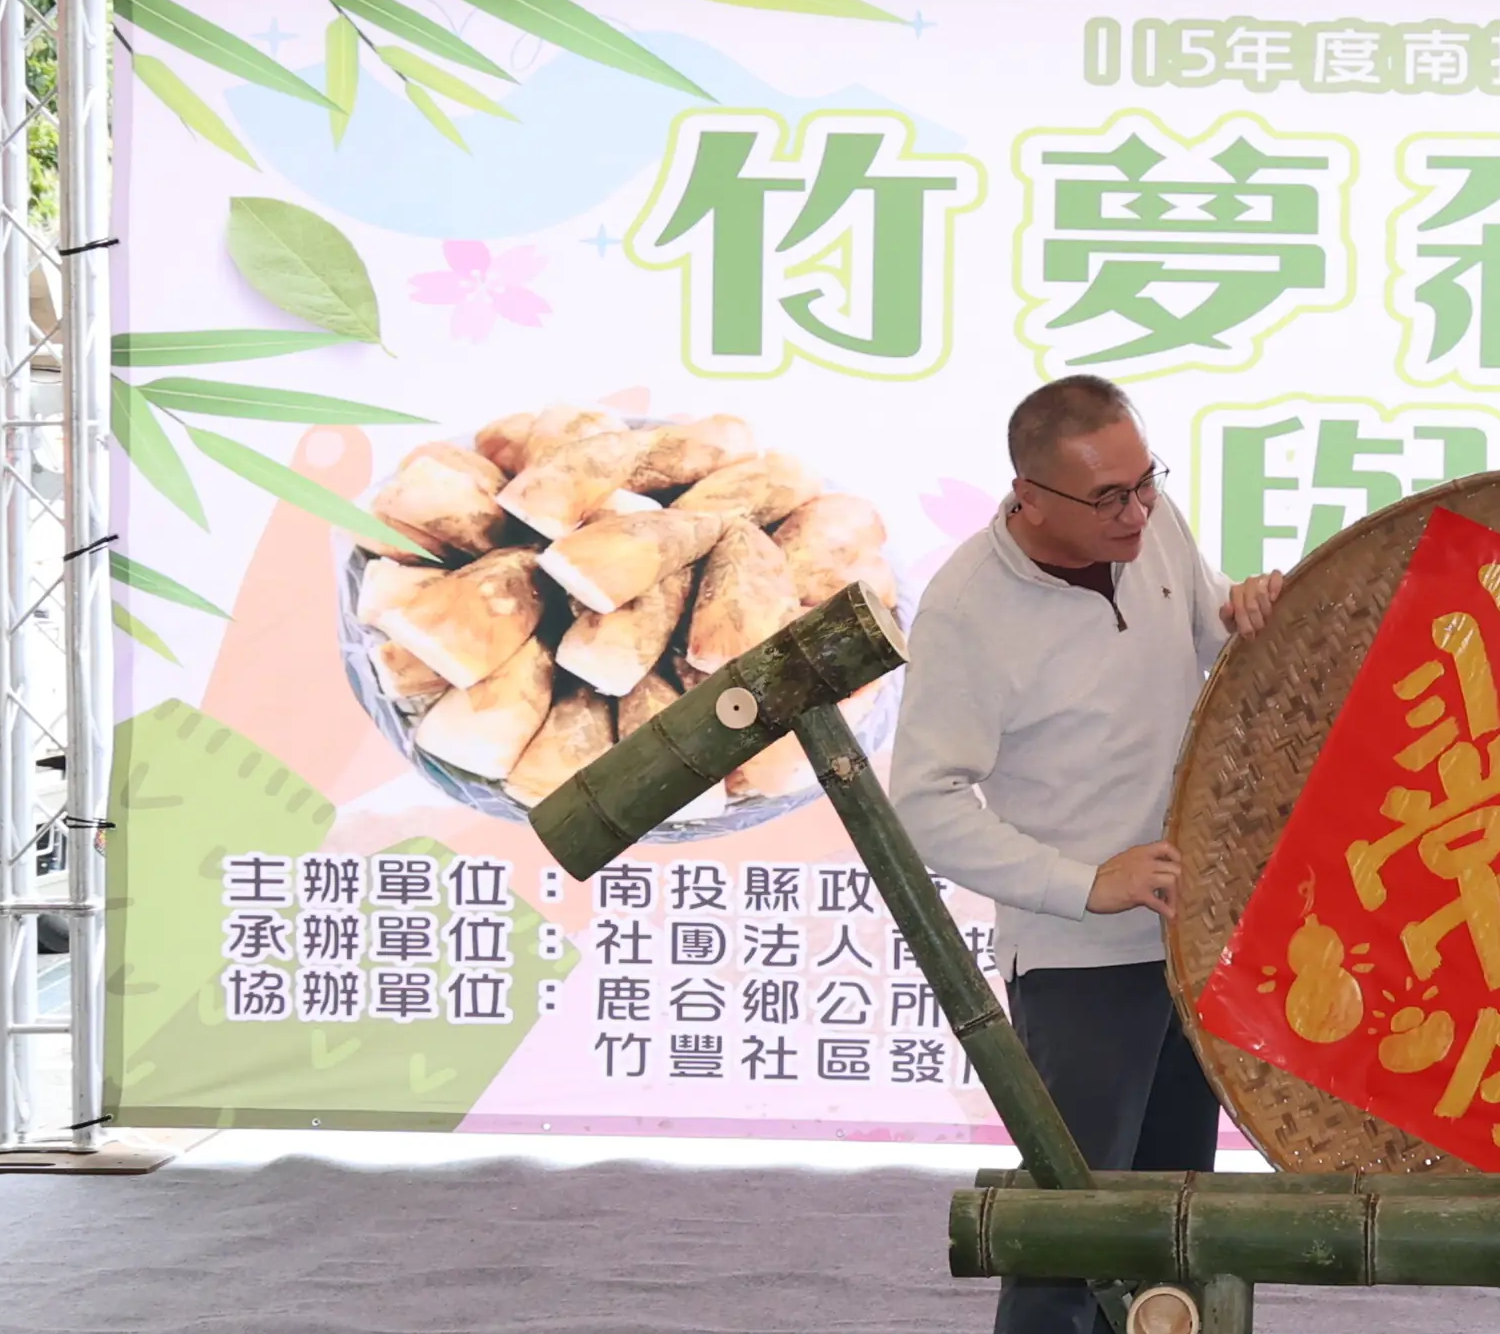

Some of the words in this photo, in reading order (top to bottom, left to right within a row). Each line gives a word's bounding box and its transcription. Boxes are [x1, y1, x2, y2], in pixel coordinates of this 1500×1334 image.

[228, 856, 947, 913] 主辦單位：南投縣政
[593, 1031, 982, 1085] 竹豐社區發
